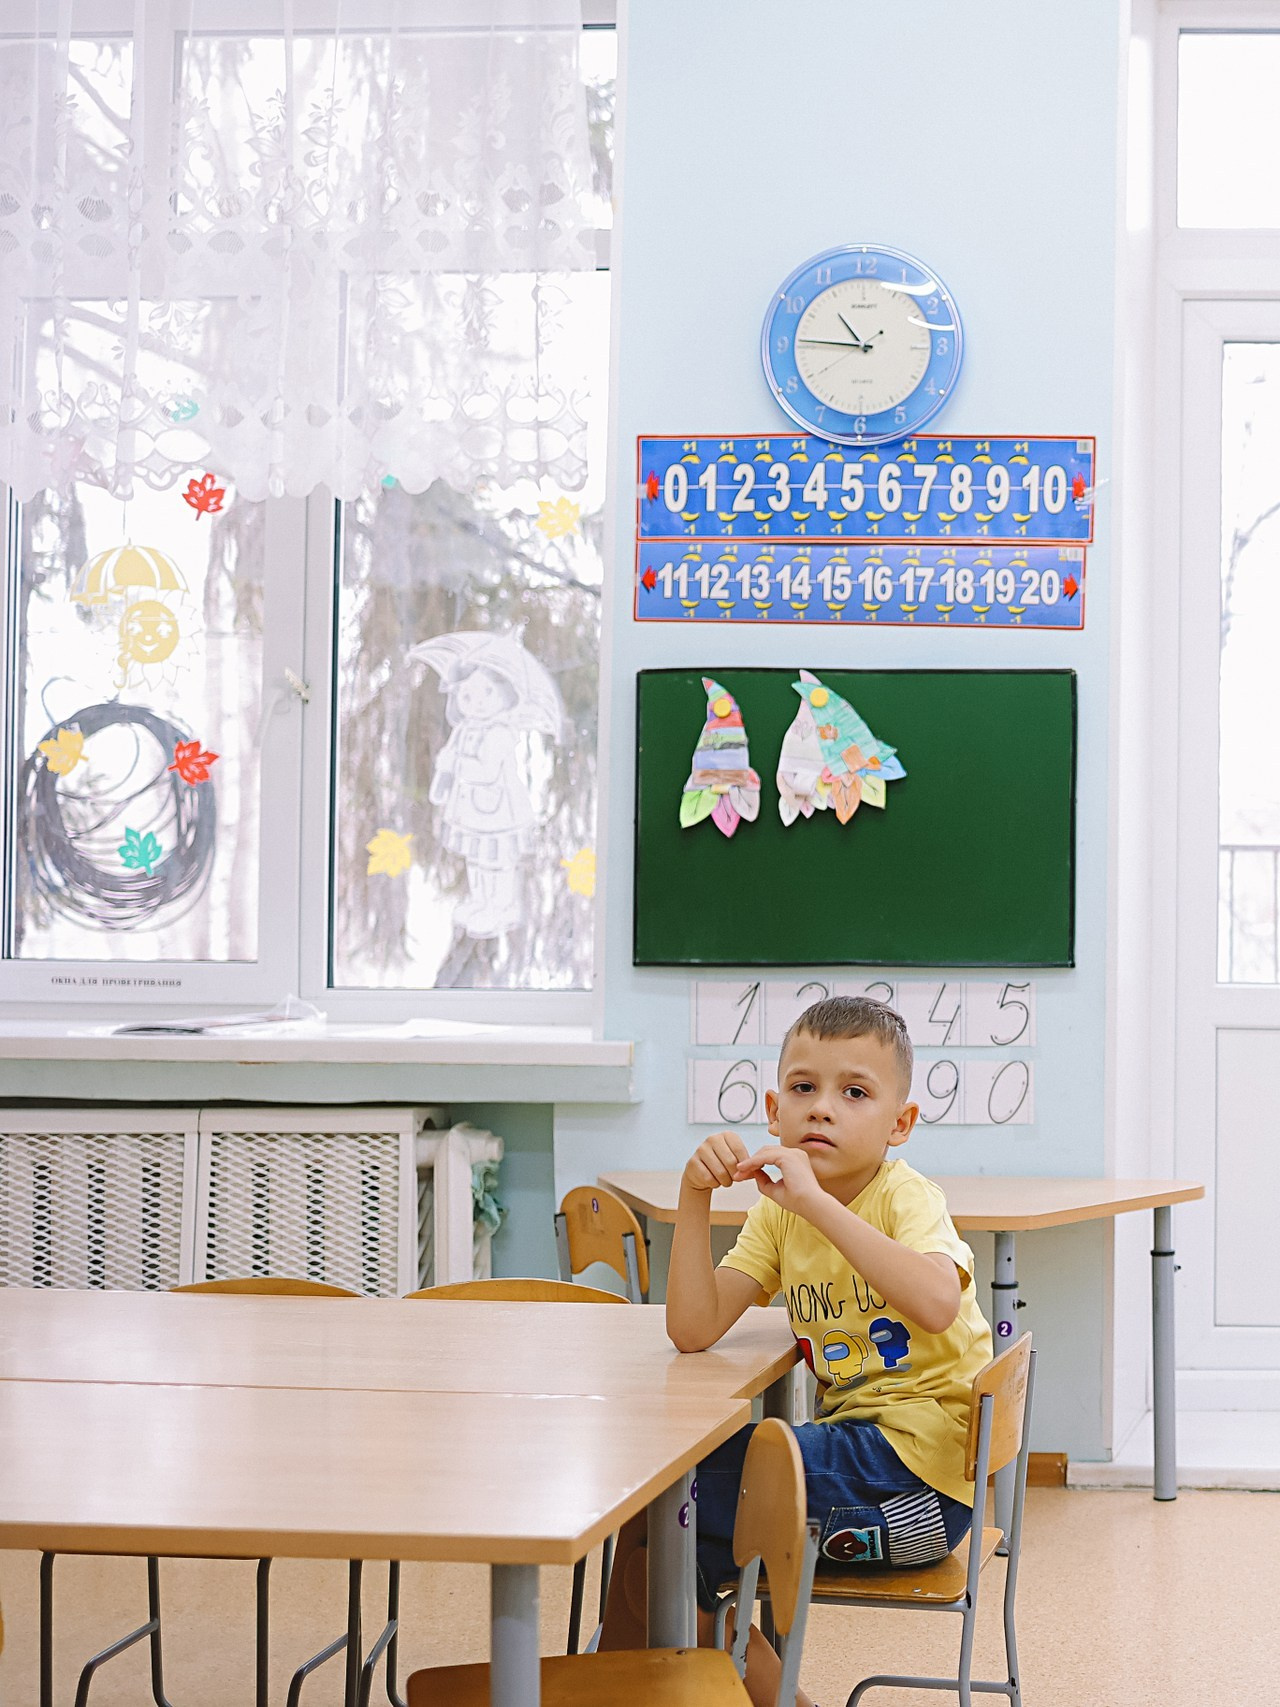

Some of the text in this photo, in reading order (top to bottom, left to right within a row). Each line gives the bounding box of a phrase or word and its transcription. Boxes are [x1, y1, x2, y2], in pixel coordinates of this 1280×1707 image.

[855, 257, 878, 274] 12
[816, 268, 832, 284] 11
[901, 269, 907, 284] 1
[786, 296, 805, 314] 10
[927, 299, 939, 315] 2
[777, 335, 789, 353] 9
[936, 337, 948, 355] 3
[786, 376, 798, 394] 8
[924, 378, 936, 395] 4
[815, 406, 825, 423] 7
[895, 406, 907, 424] 5
[853, 416, 866, 434] 6
[682, 440, 1029, 453] +1 +1 +1 +1 +1 +1 +1 +1
[664, 462, 1067, 514] 0 1 2 3 4 5 6 7 8 9 10
[657, 562, 1060, 605] 11 12 13 14 15 16 17 18 19 20
[732, 982, 1031, 1046] 1 4 5
[718, 1060, 1030, 1124] 6 9 0
[785, 1282, 845, 1323] MONG
[1000, 1323, 1009, 1336] 2
